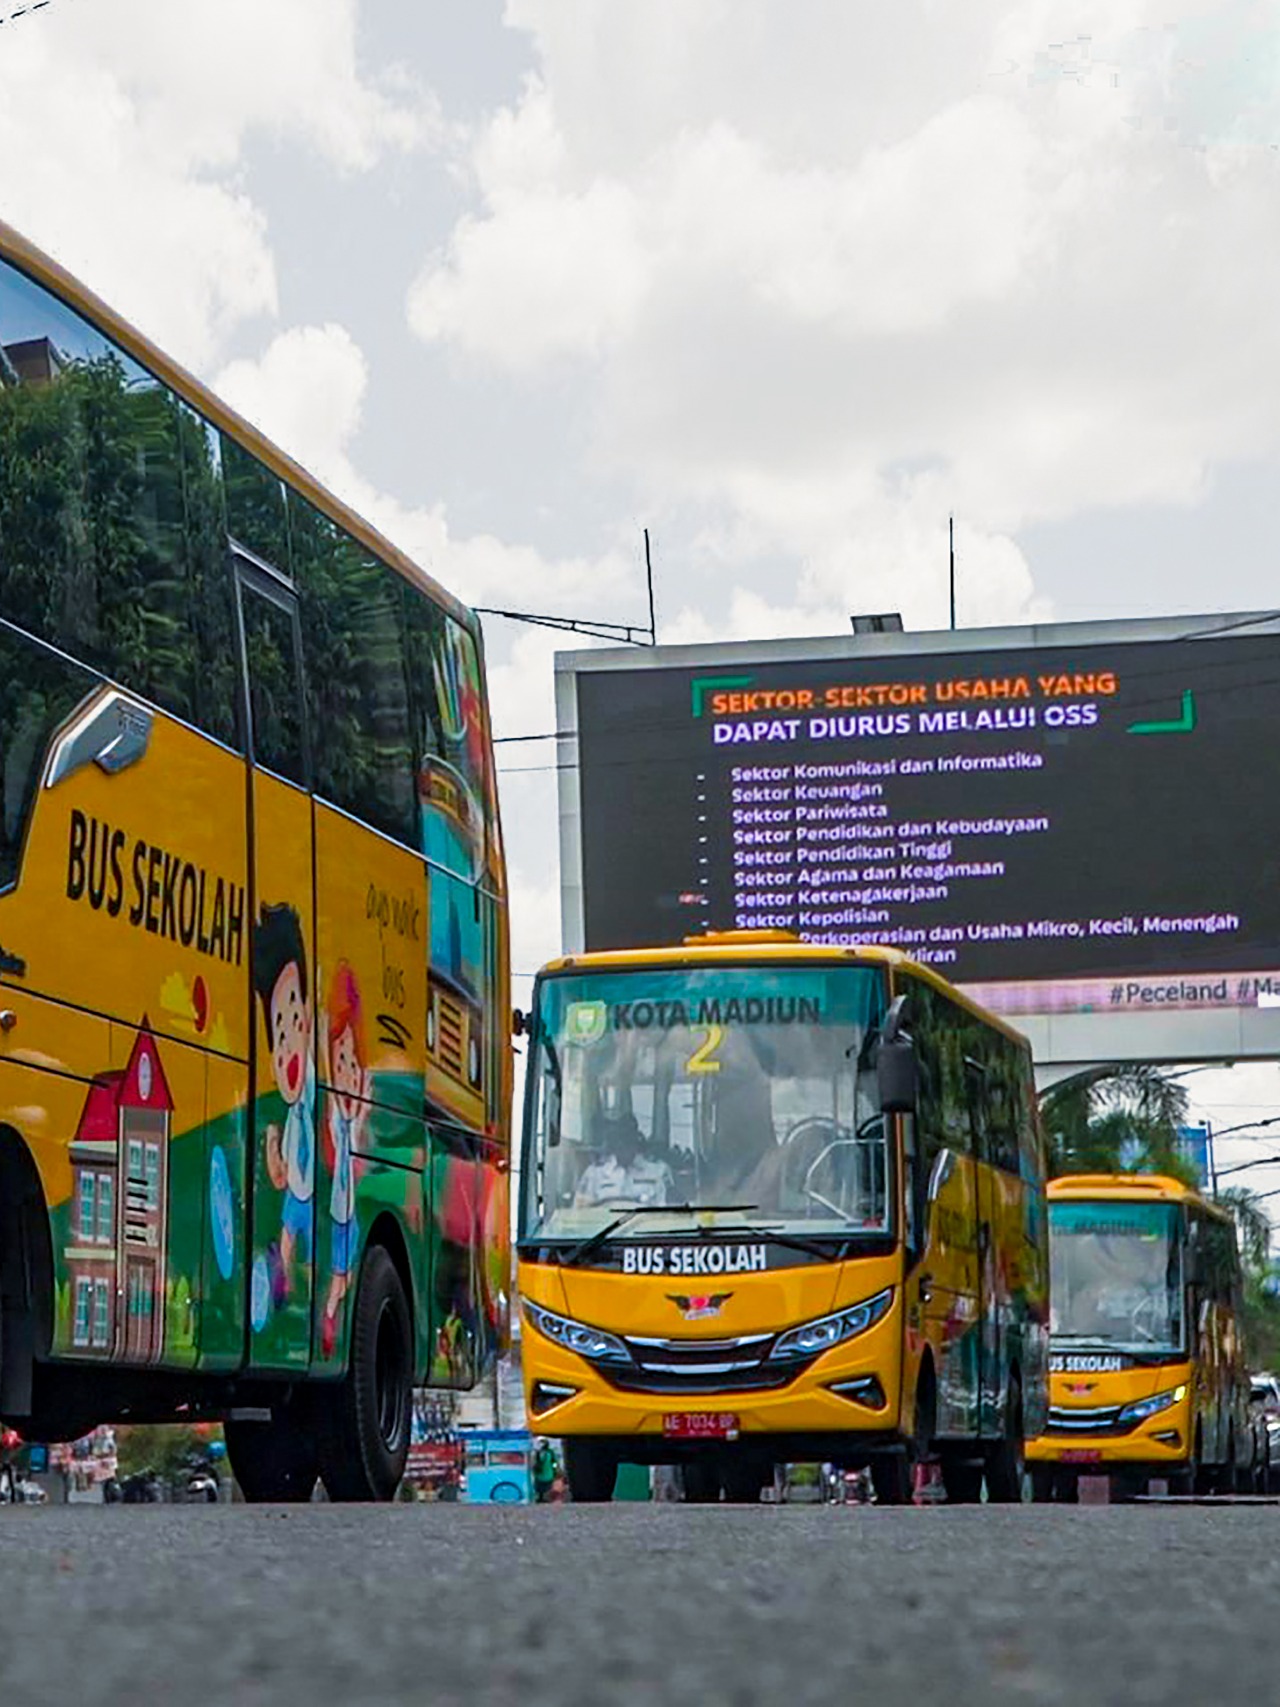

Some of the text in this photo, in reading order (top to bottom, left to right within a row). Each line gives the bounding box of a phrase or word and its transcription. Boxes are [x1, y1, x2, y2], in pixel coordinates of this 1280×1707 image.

[935, 677, 1031, 701] USAHA
[1037, 672, 1117, 696] YANG
[713, 703, 1099, 744] DAPAT DIURUS MELALUI OSS
[731, 751, 1043, 782] Sektor Komunikasi dan Informatika
[732, 782, 883, 803] Sektor Keuangan
[732, 803, 888, 824] Sektor Pariwisata
[733, 816, 1049, 845] Sektor Pendidikan dan Kebudayaan
[733, 840, 952, 867] Sektor Pendidikan Tinggi
[66, 808, 245, 967] BUS SEKOLAH
[734, 861, 1005, 887] Sektor Agama dan Keagamaan
[734, 884, 949, 908] Sektor Ketenagakerjaan
[735, 908, 890, 929] Sektor Kepolisian
[929, 926, 964, 942] dan
[967, 923, 1024, 940] Usaha
[1026, 919, 1085, 937] Mikro,
[1089, 915, 1139, 935] Kecil,
[1142, 913, 1239, 934] Menengah
[1110, 979, 1228, 1005] #Peceland
[613, 996, 819, 1030] KOTA MADIUN
[684, 1025, 726, 1076] 2
[623, 1244, 767, 1274] BUS SEKOLAH
[1066, 1355, 1122, 1371] SEKOLAH
